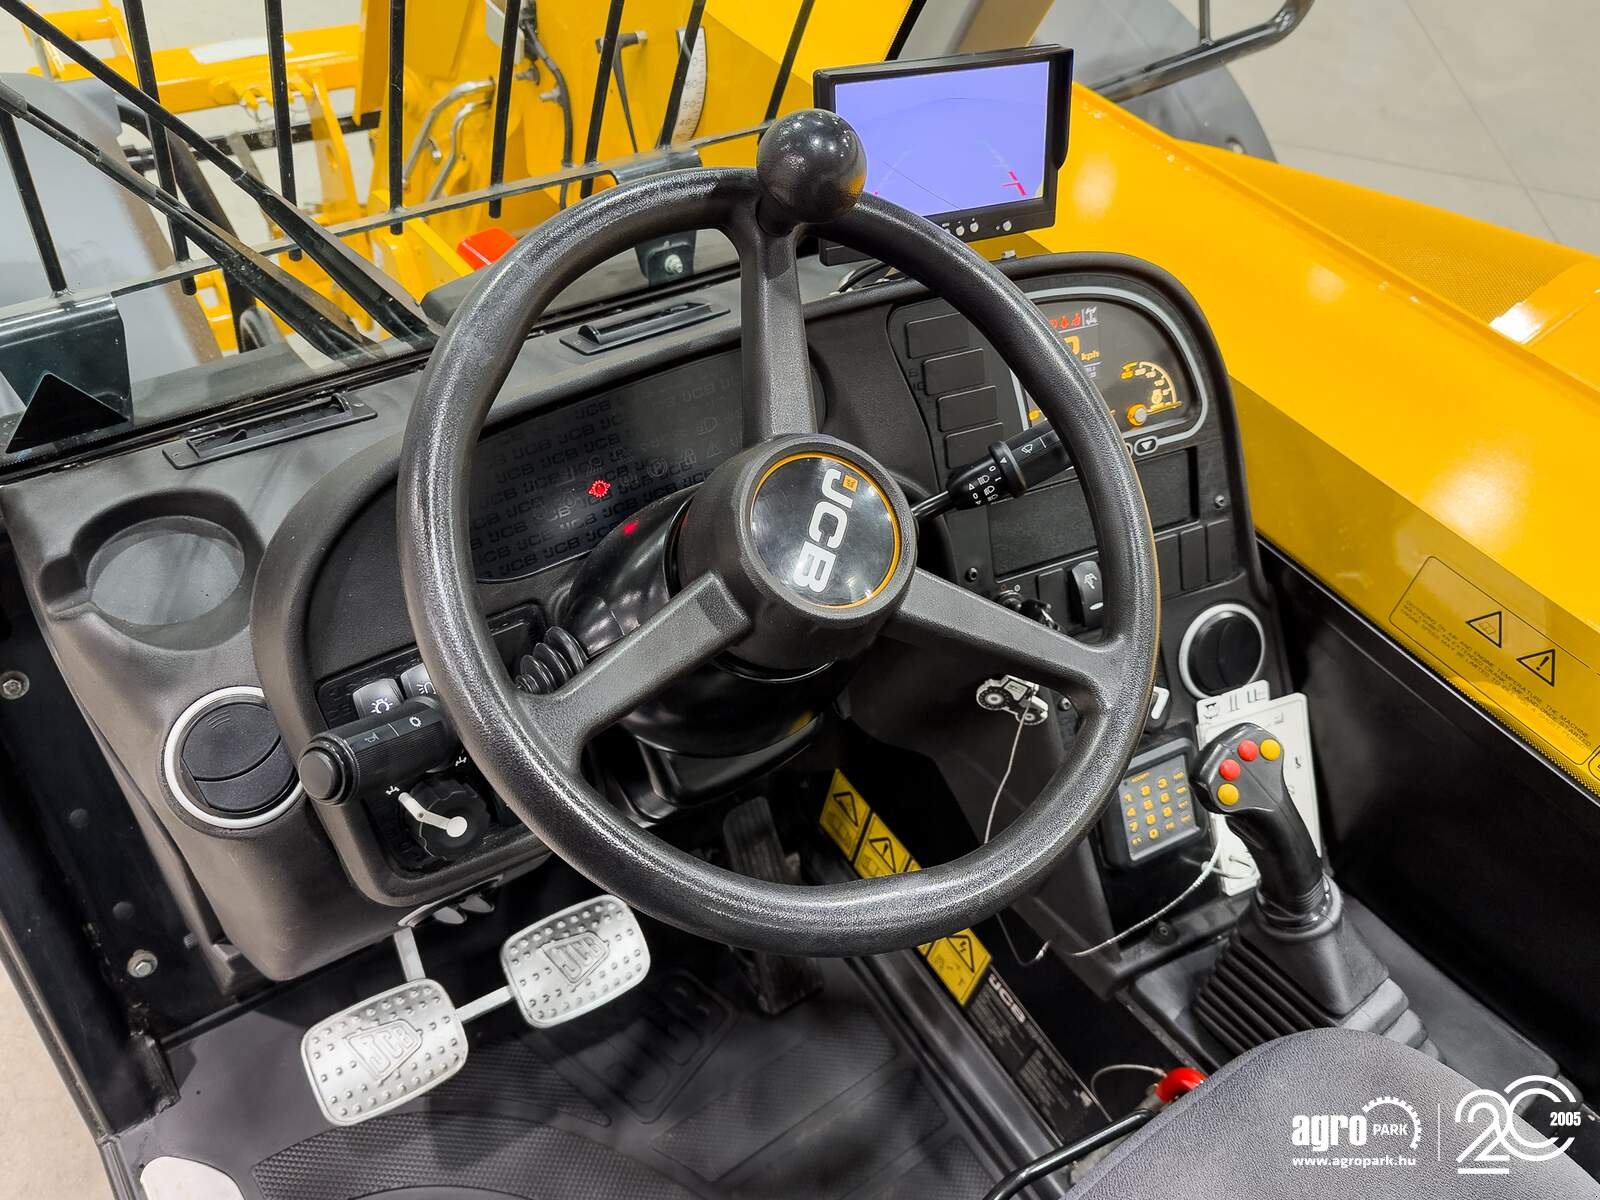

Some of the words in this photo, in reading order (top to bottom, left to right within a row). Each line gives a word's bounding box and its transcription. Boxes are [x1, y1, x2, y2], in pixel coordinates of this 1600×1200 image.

[682, 99, 696, 110] 50
[793, 468, 857, 594] JCB
[498, 553, 538, 576] JCB
[543, 536, 581, 559] JCB
[555, 937, 605, 980] JCB
[988, 973, 1026, 1024] JCB
[361, 1025, 417, 1073] JCB
